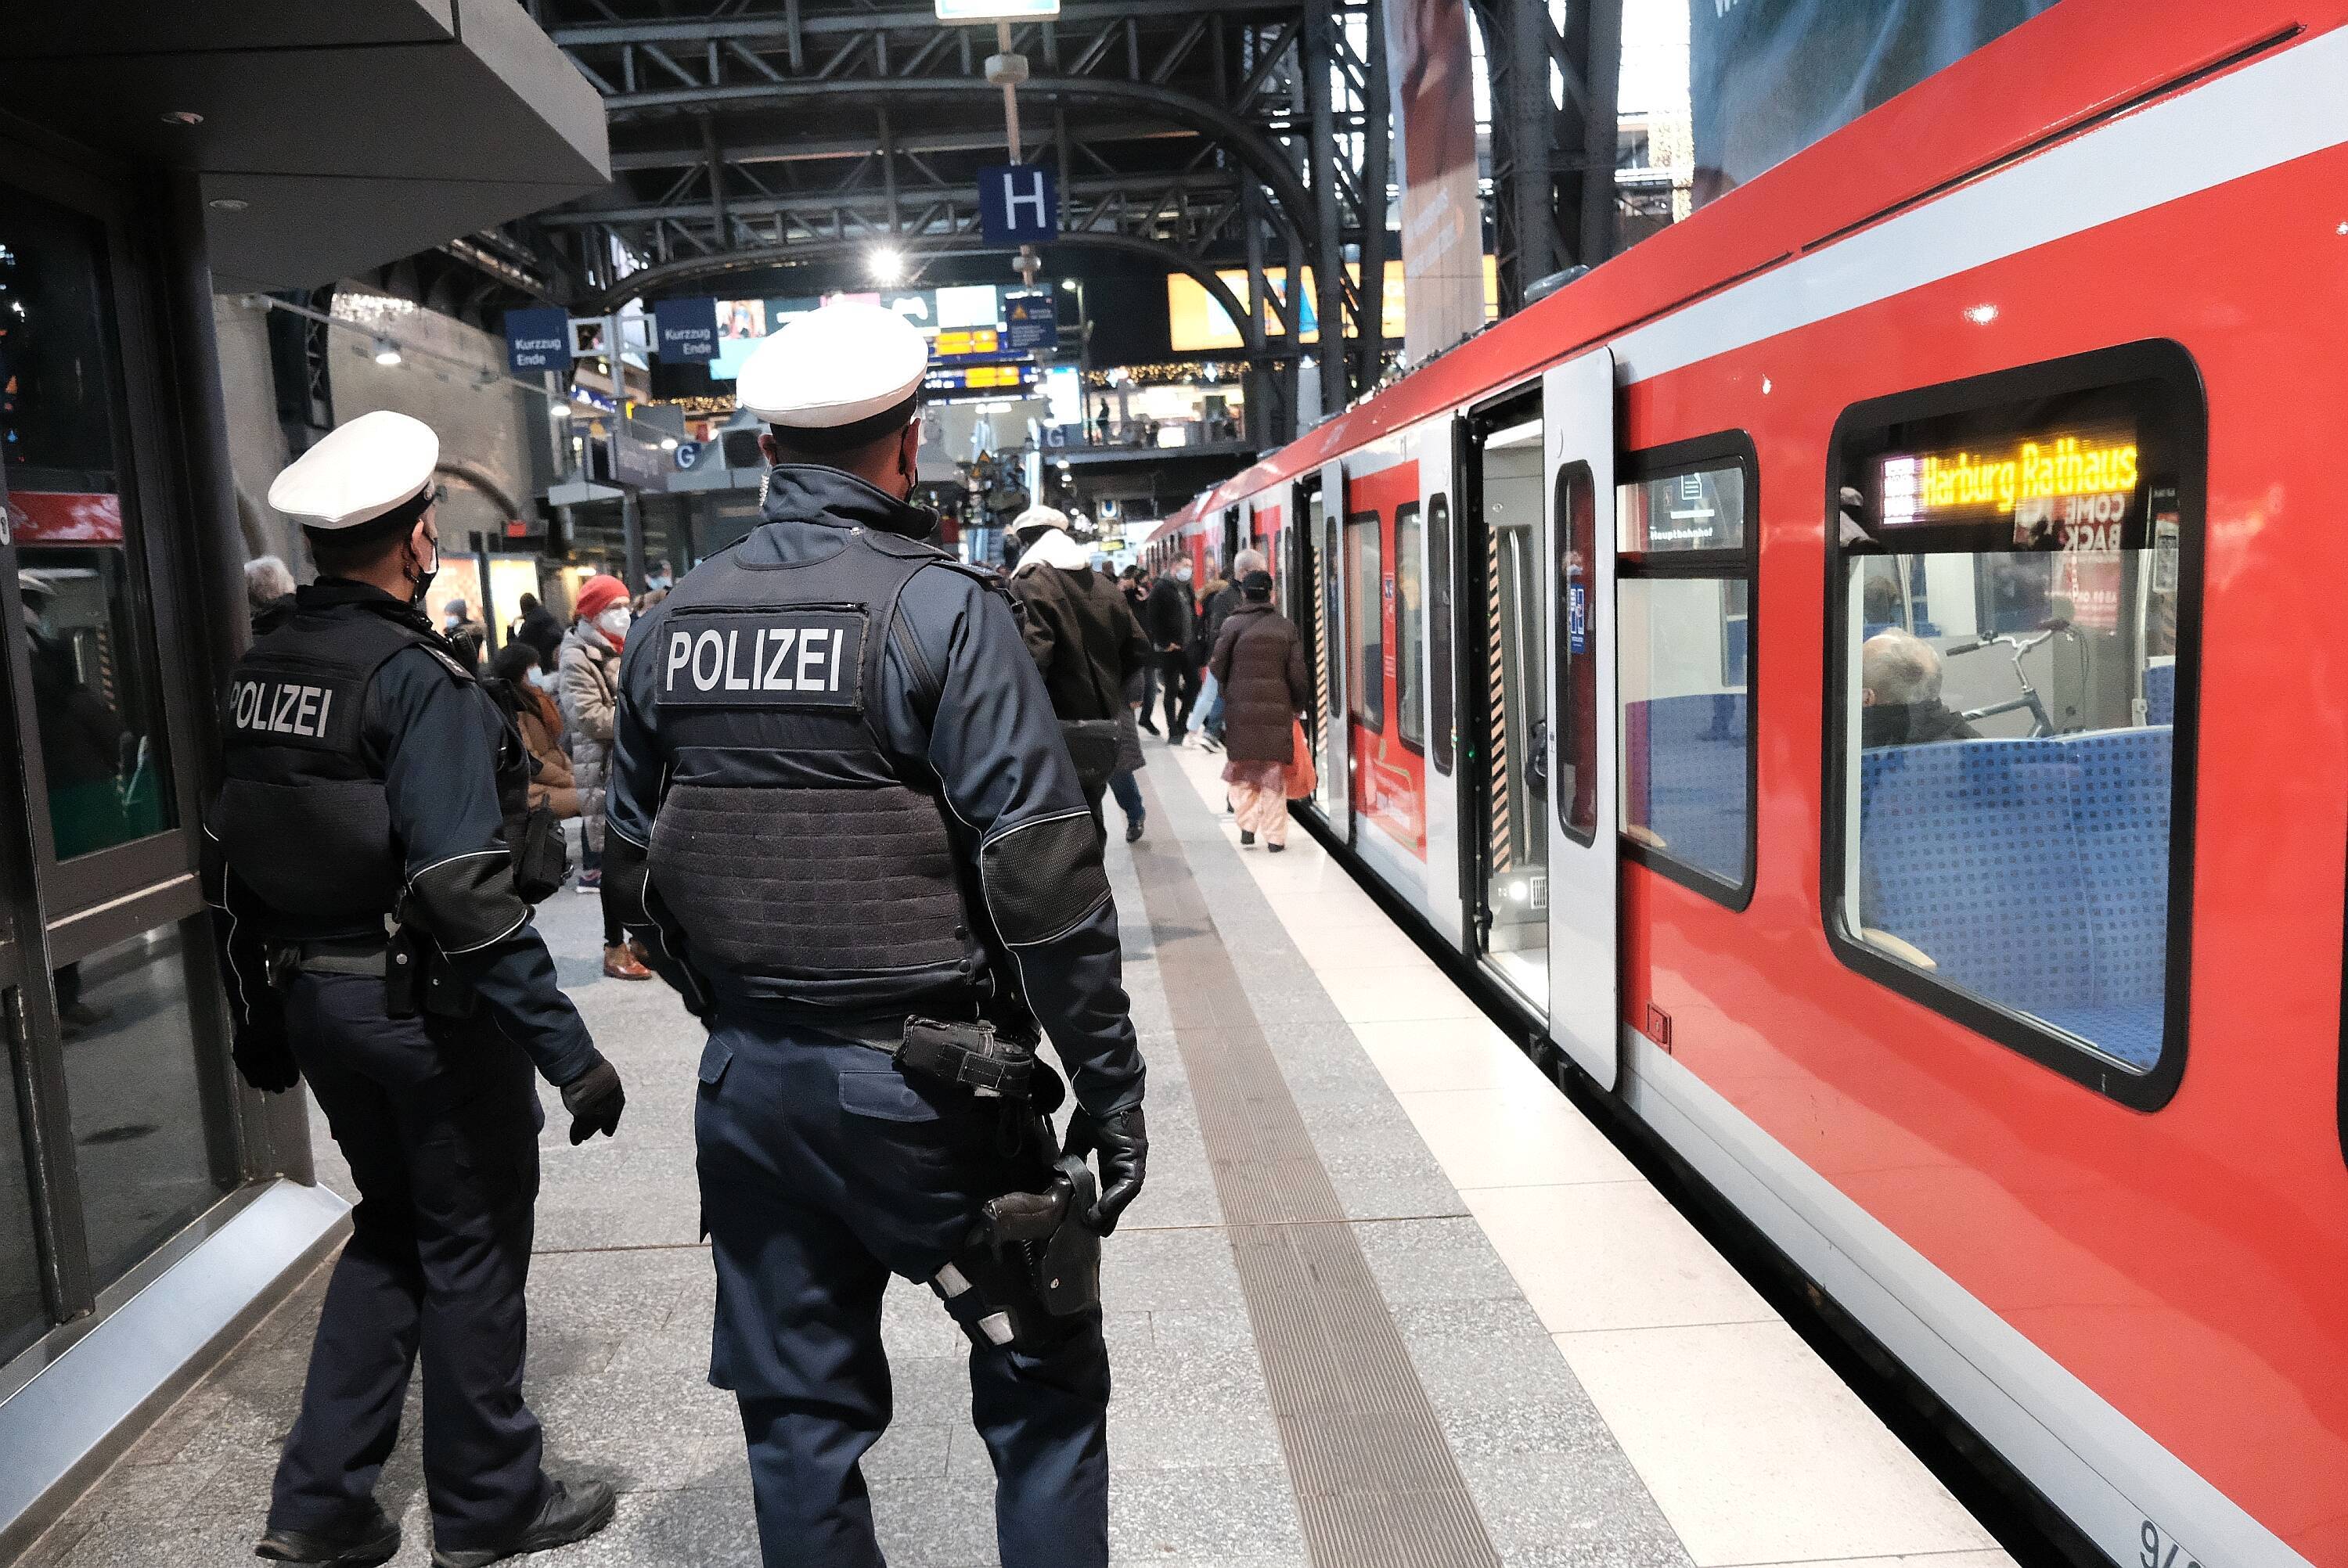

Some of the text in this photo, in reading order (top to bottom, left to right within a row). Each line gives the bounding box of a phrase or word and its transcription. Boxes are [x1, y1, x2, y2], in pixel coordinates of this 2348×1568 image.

[1003, 171, 1046, 230] H
[665, 329, 711, 340] Kurzzug
[515, 339, 561, 351] Kurzzug
[683, 343, 711, 355] Ende
[517, 354, 546, 366] Ende
[677, 444, 695, 468] G
[1923, 453, 2015, 512] Harburg
[2022, 437, 2137, 498] Rathaus
[1650, 527, 1712, 541] Hauptbahnhof
[666, 629, 844, 692] POLIZEI
[229, 681, 333, 738] POLIZEI
